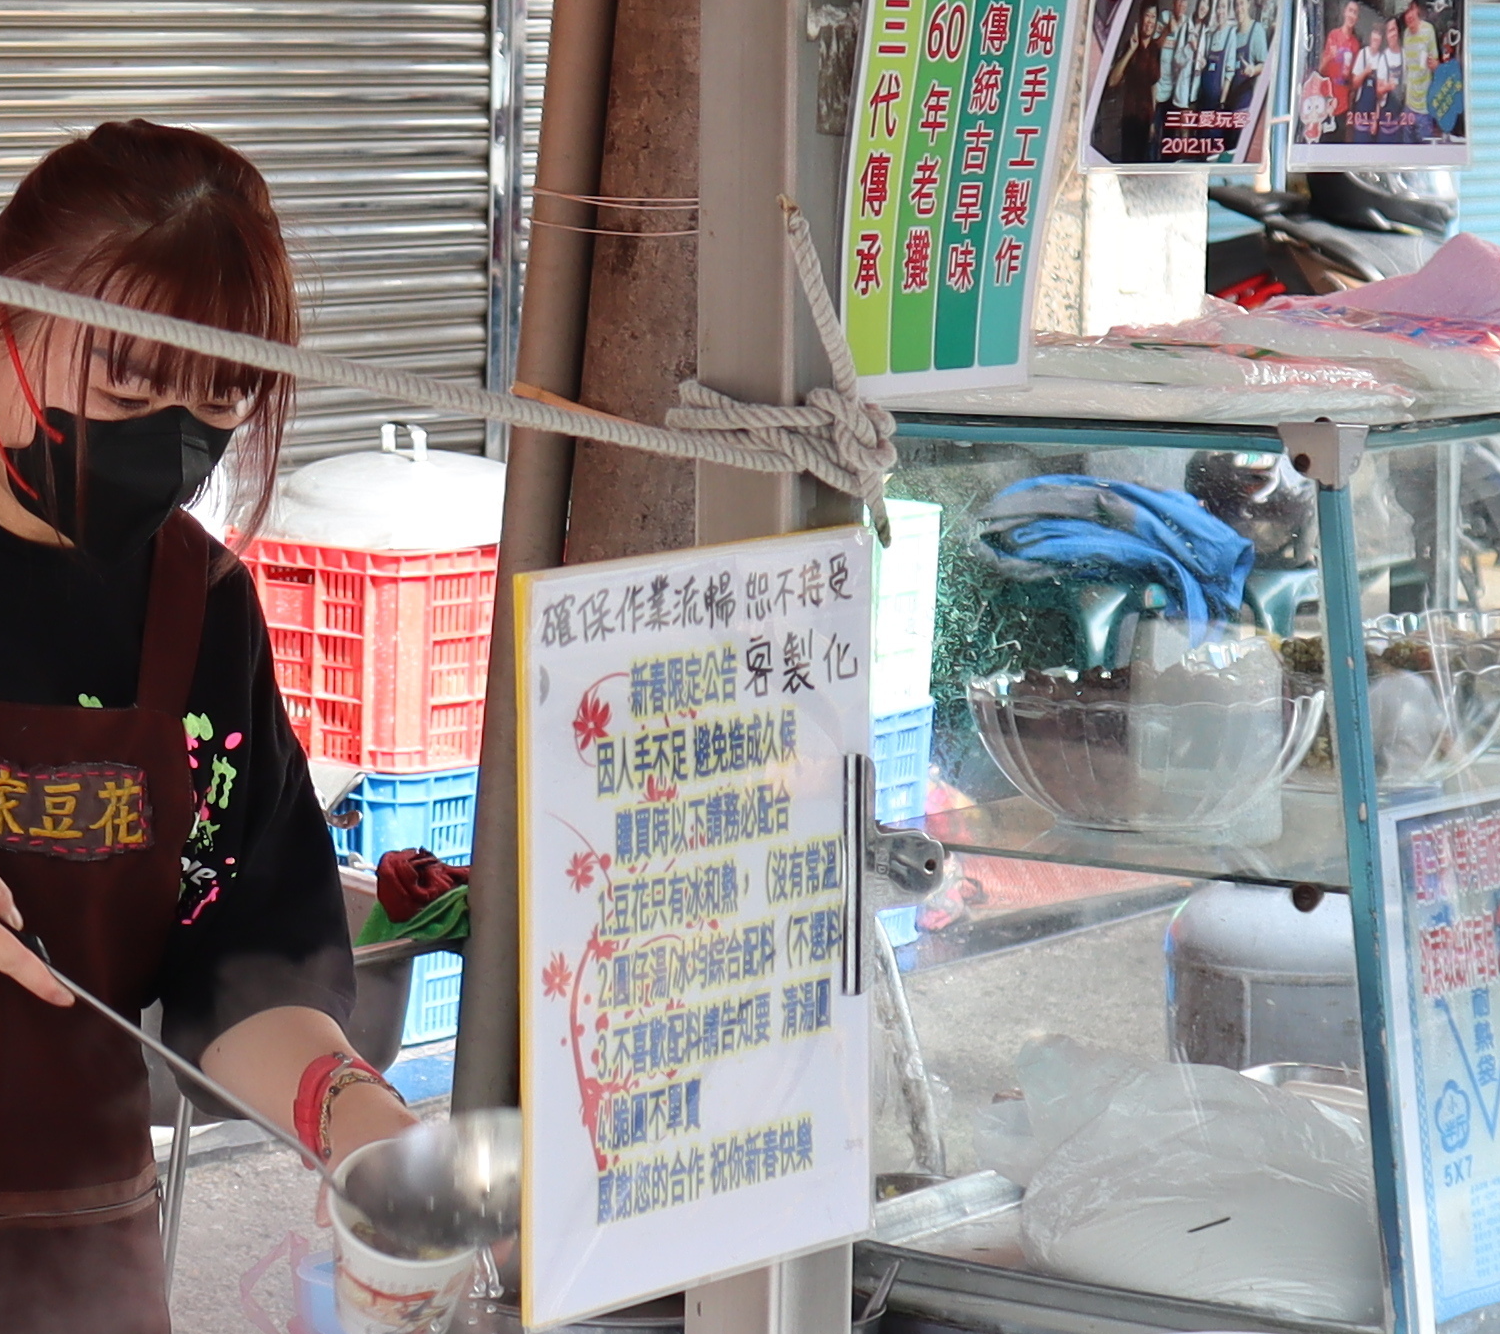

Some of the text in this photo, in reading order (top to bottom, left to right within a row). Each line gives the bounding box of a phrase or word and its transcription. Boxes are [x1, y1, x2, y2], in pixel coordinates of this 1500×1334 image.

[902, 1, 968, 294] 60年老攤
[945, 1, 1012, 292] 傳統古早味
[993, 7, 1059, 286] 純手工製作
[541, 552, 853, 648] 確保作業流暢 恕不接受
[629, 648, 738, 718] 新春限定公告
[744, 631, 858, 698] 客製化
[596, 733, 690, 797] 因人手不足
